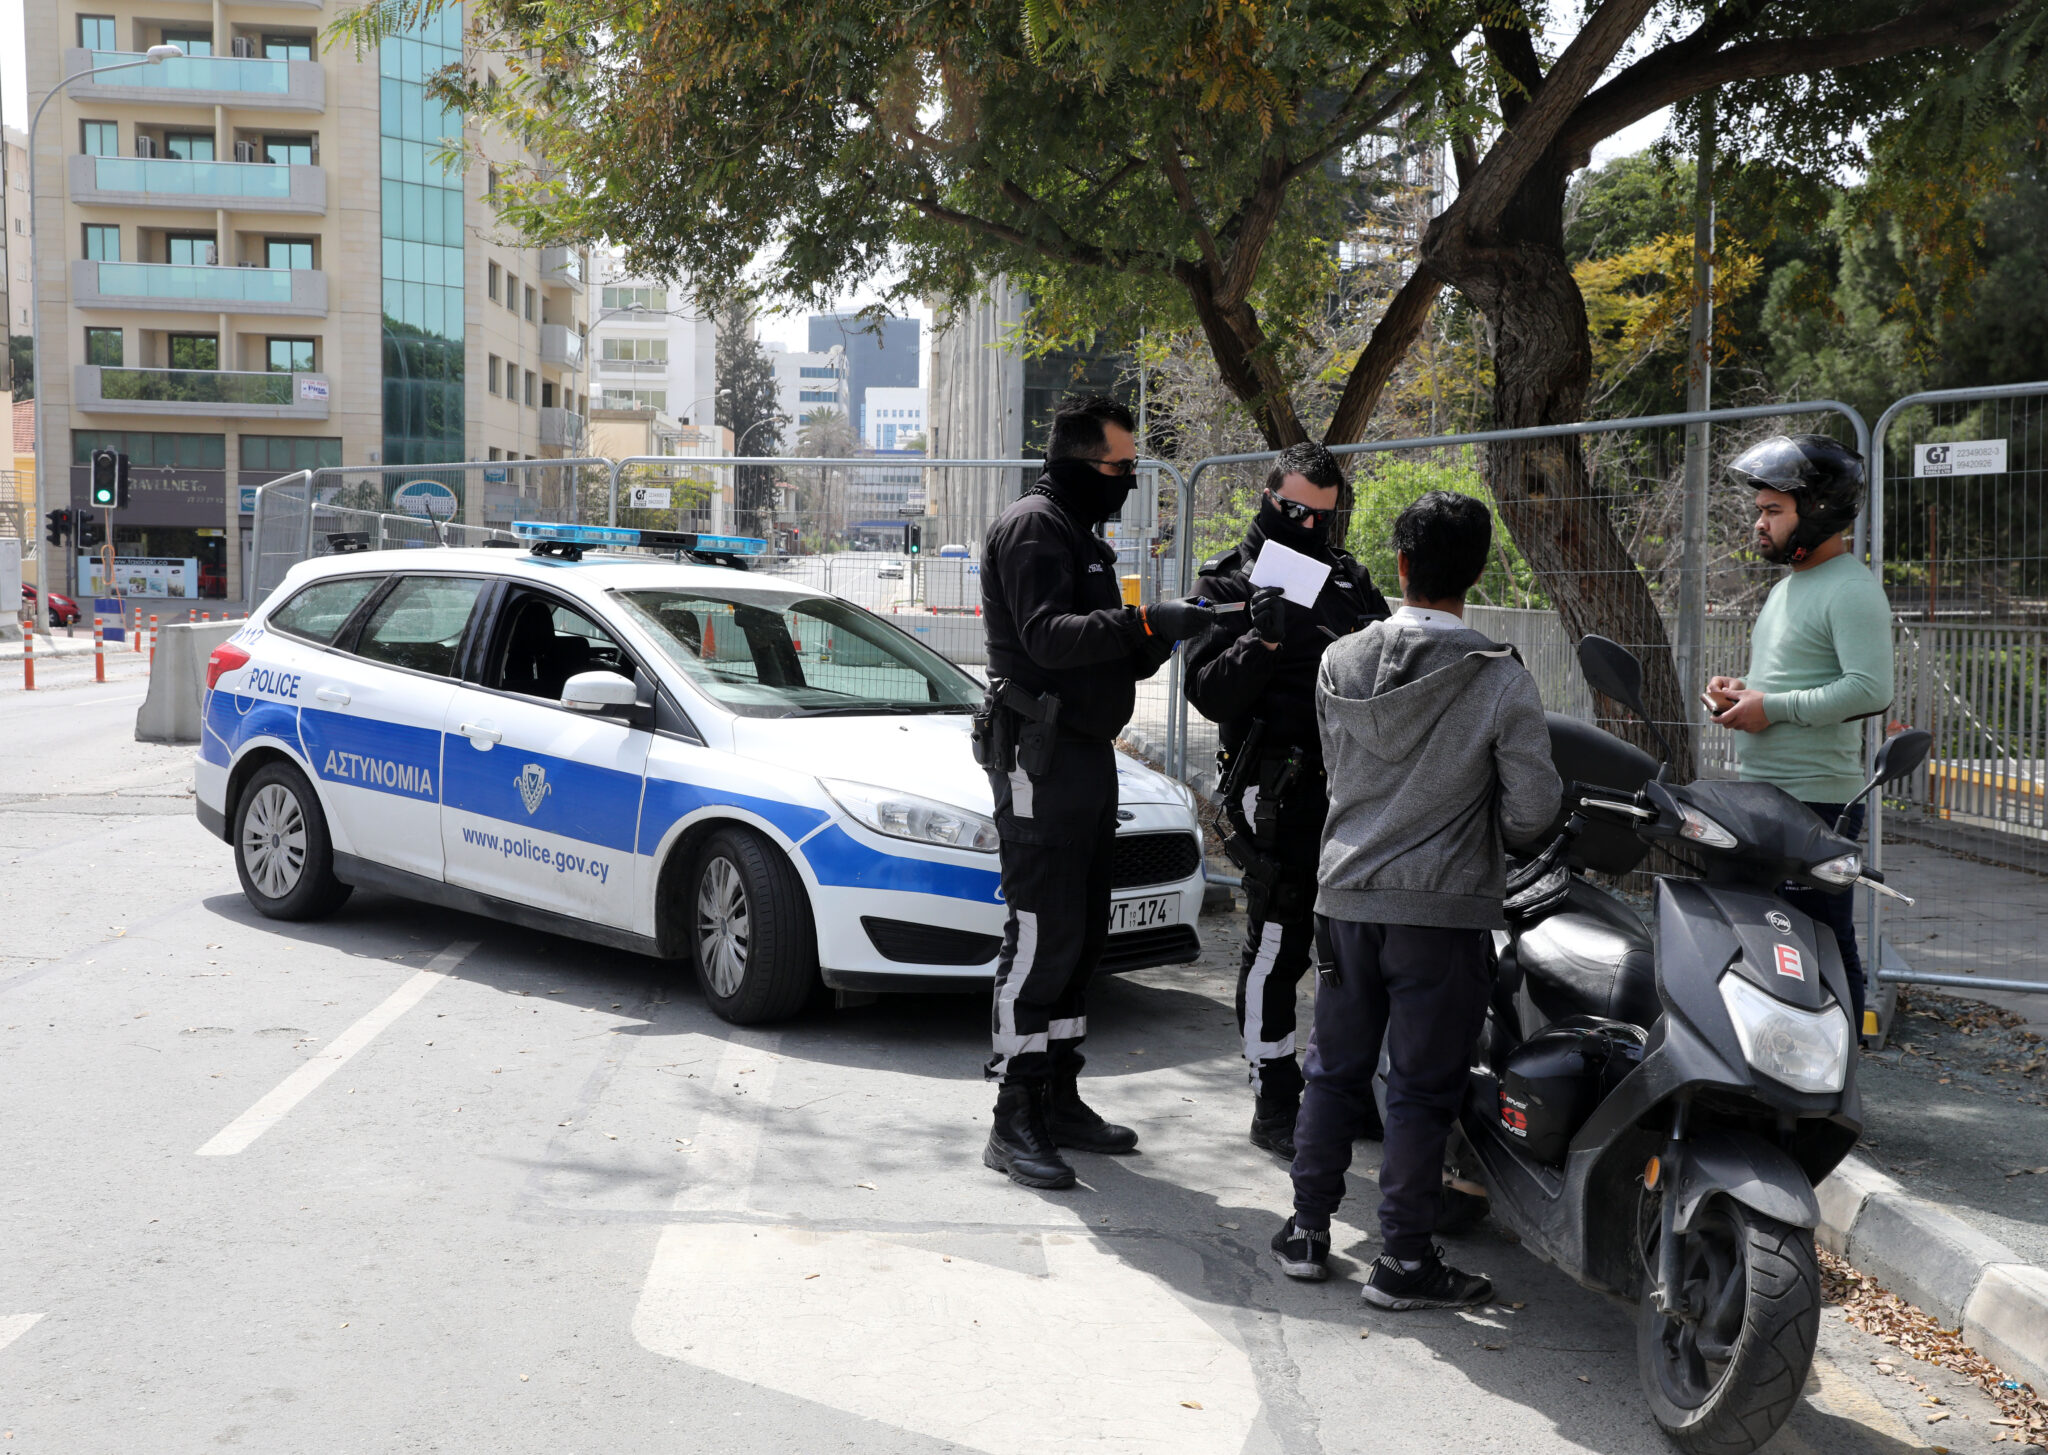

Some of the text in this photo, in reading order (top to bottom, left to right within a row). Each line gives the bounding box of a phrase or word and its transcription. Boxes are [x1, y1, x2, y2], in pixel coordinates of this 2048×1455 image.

[1926, 446, 1950, 464] GT
[128, 478, 199, 492] RAVELNET
[635, 489, 647, 500] GT
[240, 627, 264, 646] 112
[248, 667, 302, 699] POLICE
[323, 749, 433, 796] ΑΣΤΥΝΟΜΙΑ
[462, 827, 609, 884] www.police.gov.cy
[1137, 899, 1167, 926] 174
[1777, 946, 1802, 977] E
